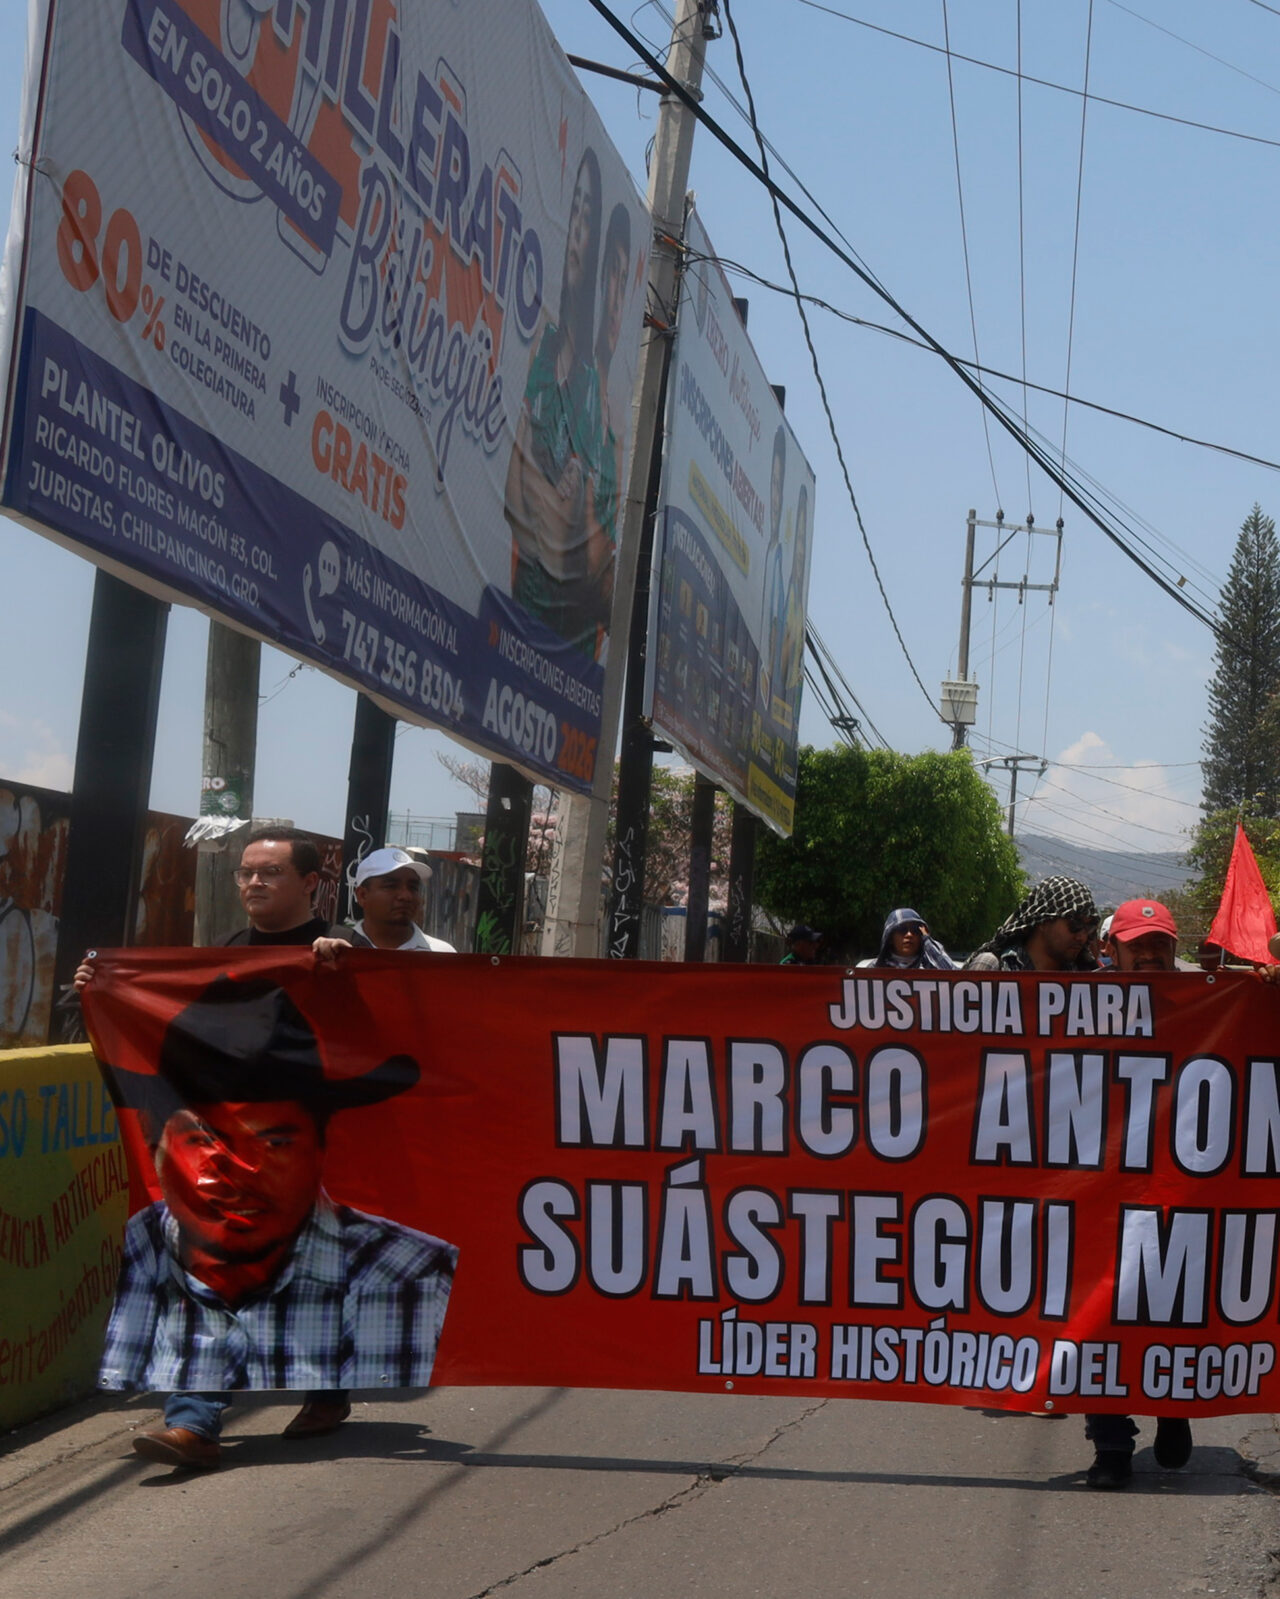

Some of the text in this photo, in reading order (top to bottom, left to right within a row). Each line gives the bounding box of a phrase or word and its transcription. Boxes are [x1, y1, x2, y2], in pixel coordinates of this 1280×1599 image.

[148, 6, 326, 221] EN SOLO 2 AÑOS
[147, 237, 271, 361] DE DESCUENTO
[174, 304, 266, 394] EN LA PRIMERA
[41, 357, 225, 508] PLANTEL OLIVOS
[171, 340, 255, 421] COLEGIATURA
[36, 415, 115, 484] RICARDO
[118, 465, 174, 520] FLORES
[177, 502, 228, 551] MAGÓN
[251, 545, 278, 580] COL.
[311, 409, 408, 529] GRATIS
[29, 461, 260, 608] JURISTAS, CHILPANCINGO, GRO.
[345, 556, 458, 656] MÁS INFORMACIÓN AL
[342, 609, 464, 720] 747 356 8304
[499, 627, 600, 718] INSCRIPCIONES ABIERTAS
[482, 677, 557, 762] AGOSTO
[829, 978, 1153, 1037] JUSTICIA PARA
[39, 1080, 120, 1155] TALLE
[551, 1031, 928, 1162] MARCO
[52, 1145, 129, 1252] ARTIFICIAL
[517, 1153, 1075, 1322] SUÁSTEGUI
[697, 1307, 1275, 1400] LÍDER HISTÓRICO DEL CECOP
